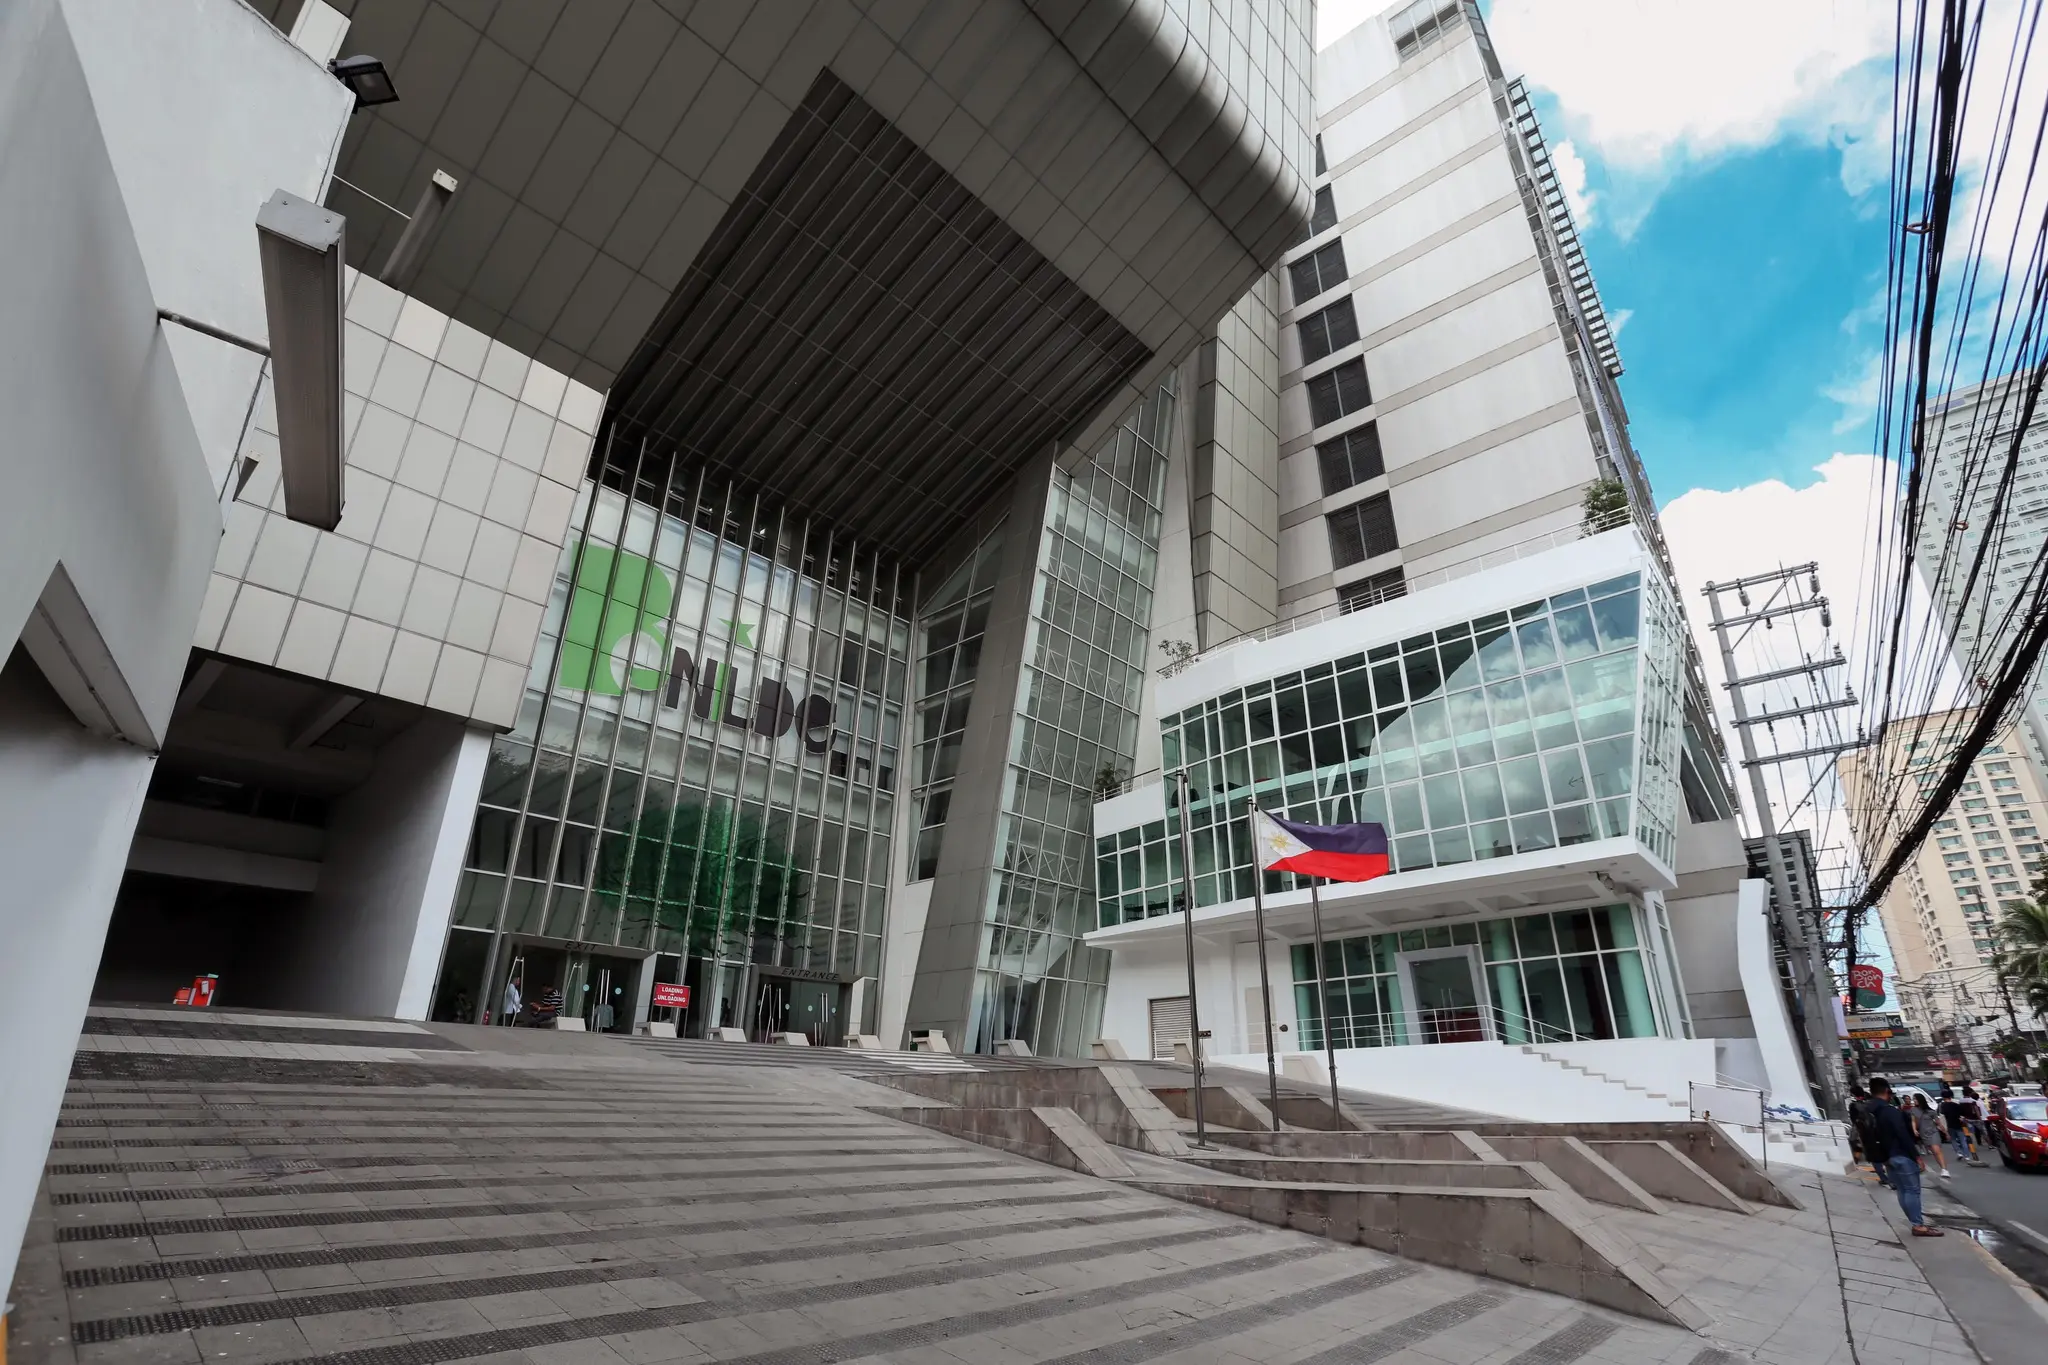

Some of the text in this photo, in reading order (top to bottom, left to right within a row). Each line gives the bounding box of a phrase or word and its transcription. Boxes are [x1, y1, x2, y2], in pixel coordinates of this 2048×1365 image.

[565, 941, 597, 951] EXIT
[781, 967, 840, 981] ENTRANCE
[661, 986, 684, 995] LOADING
[657, 994, 686, 1003] UNLOADING
